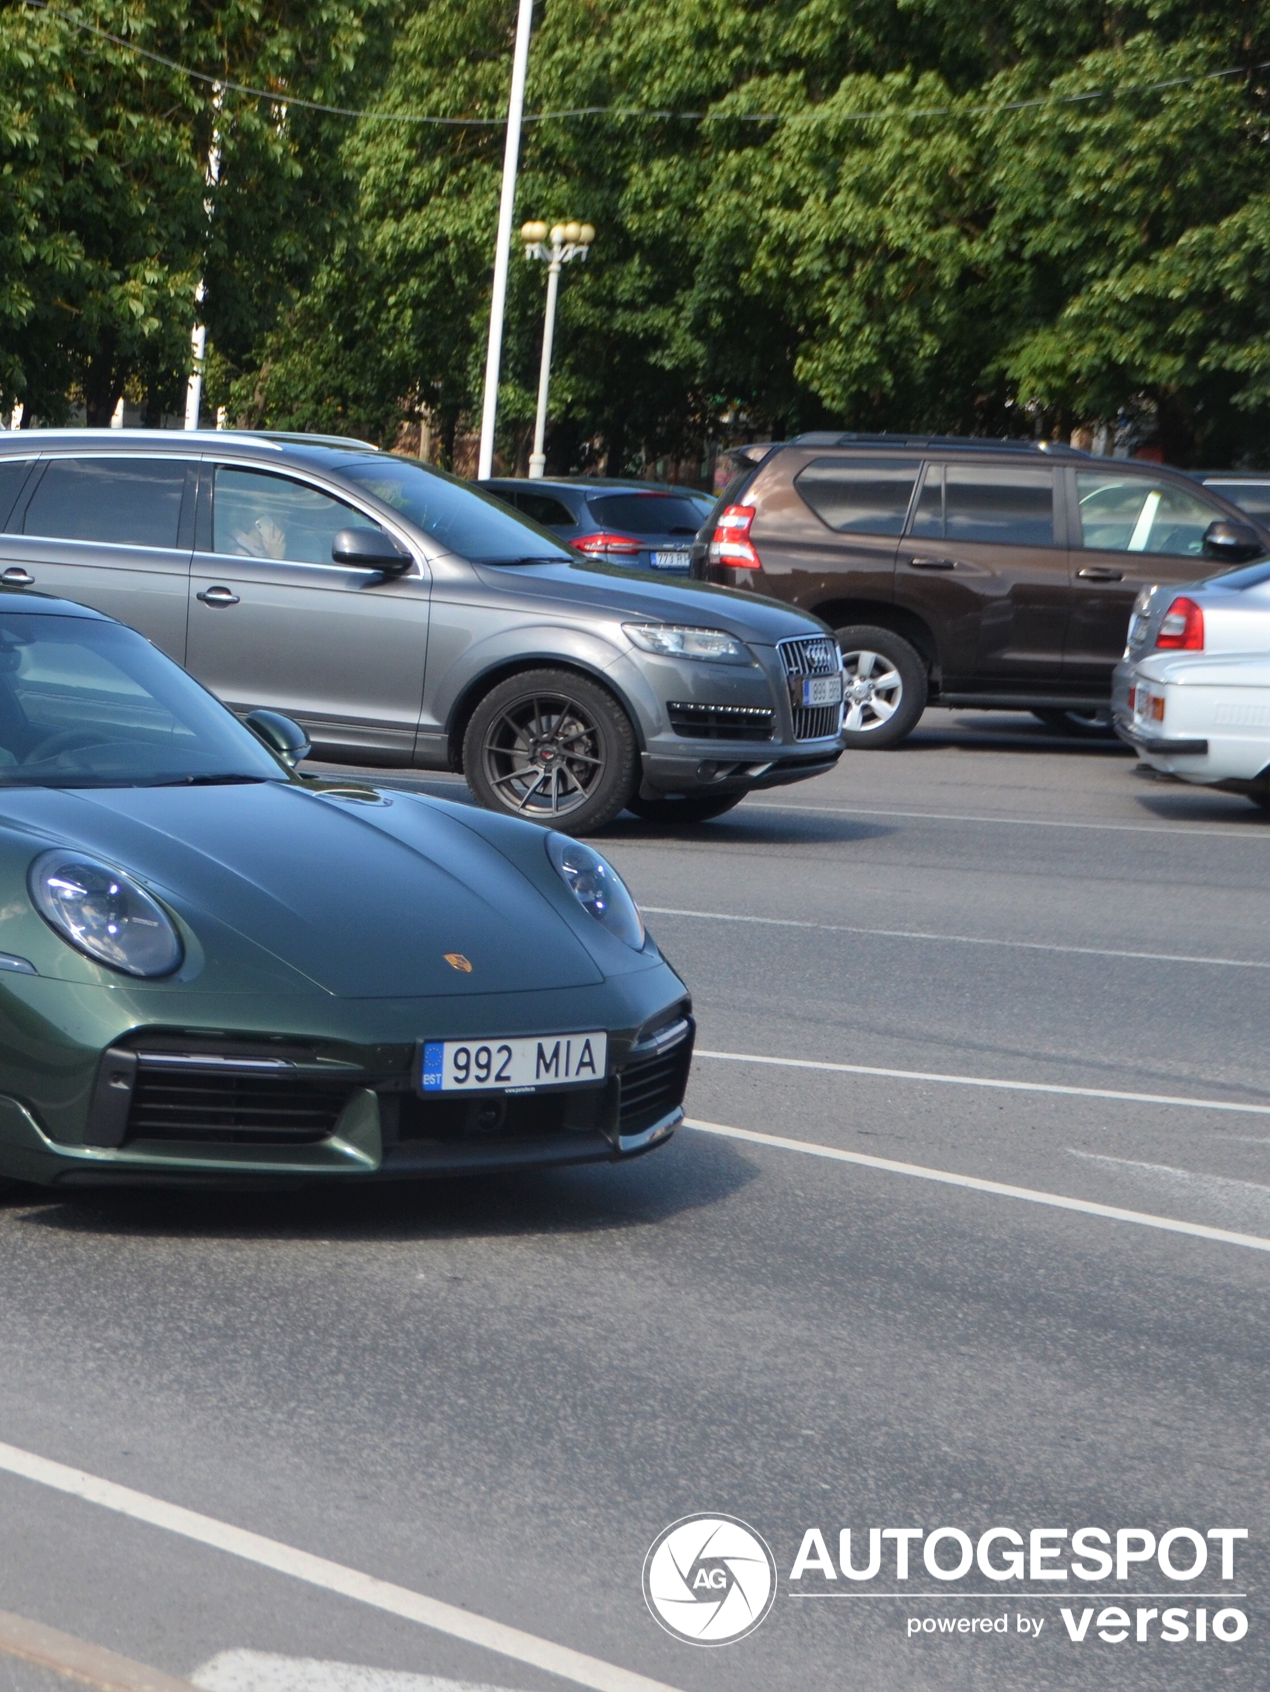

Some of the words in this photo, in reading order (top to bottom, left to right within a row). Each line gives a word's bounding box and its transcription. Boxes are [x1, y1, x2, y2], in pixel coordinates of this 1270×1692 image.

[423, 1073, 442, 1085] EST
[453, 1044, 513, 1084] 992
[535, 1038, 596, 1080] MIA
